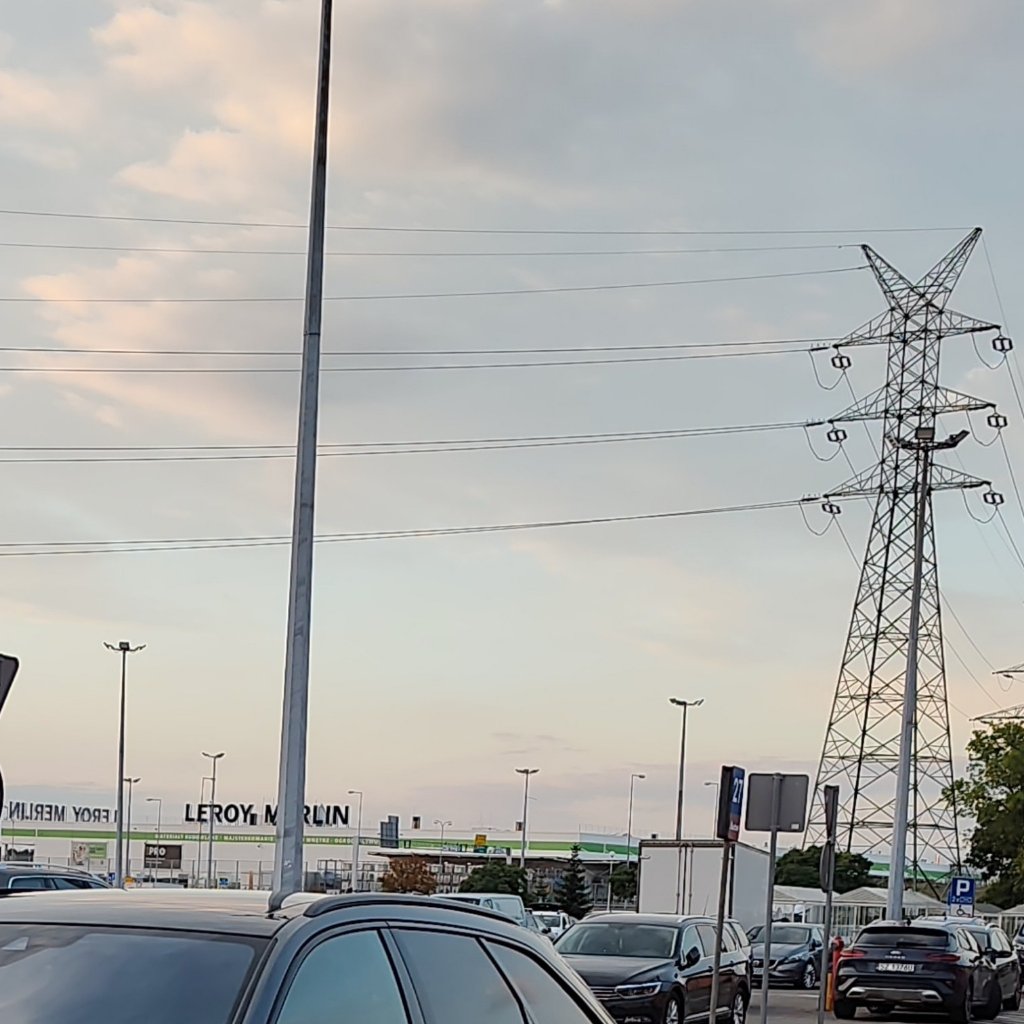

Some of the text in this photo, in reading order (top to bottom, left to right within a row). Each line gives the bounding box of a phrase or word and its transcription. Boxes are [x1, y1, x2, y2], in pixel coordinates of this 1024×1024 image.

[732, 777, 744, 804] 27
[184, 803, 350, 825] LEROY MRLIN
[148, 846, 166, 856] PRO
[956, 879, 971, 897] P
